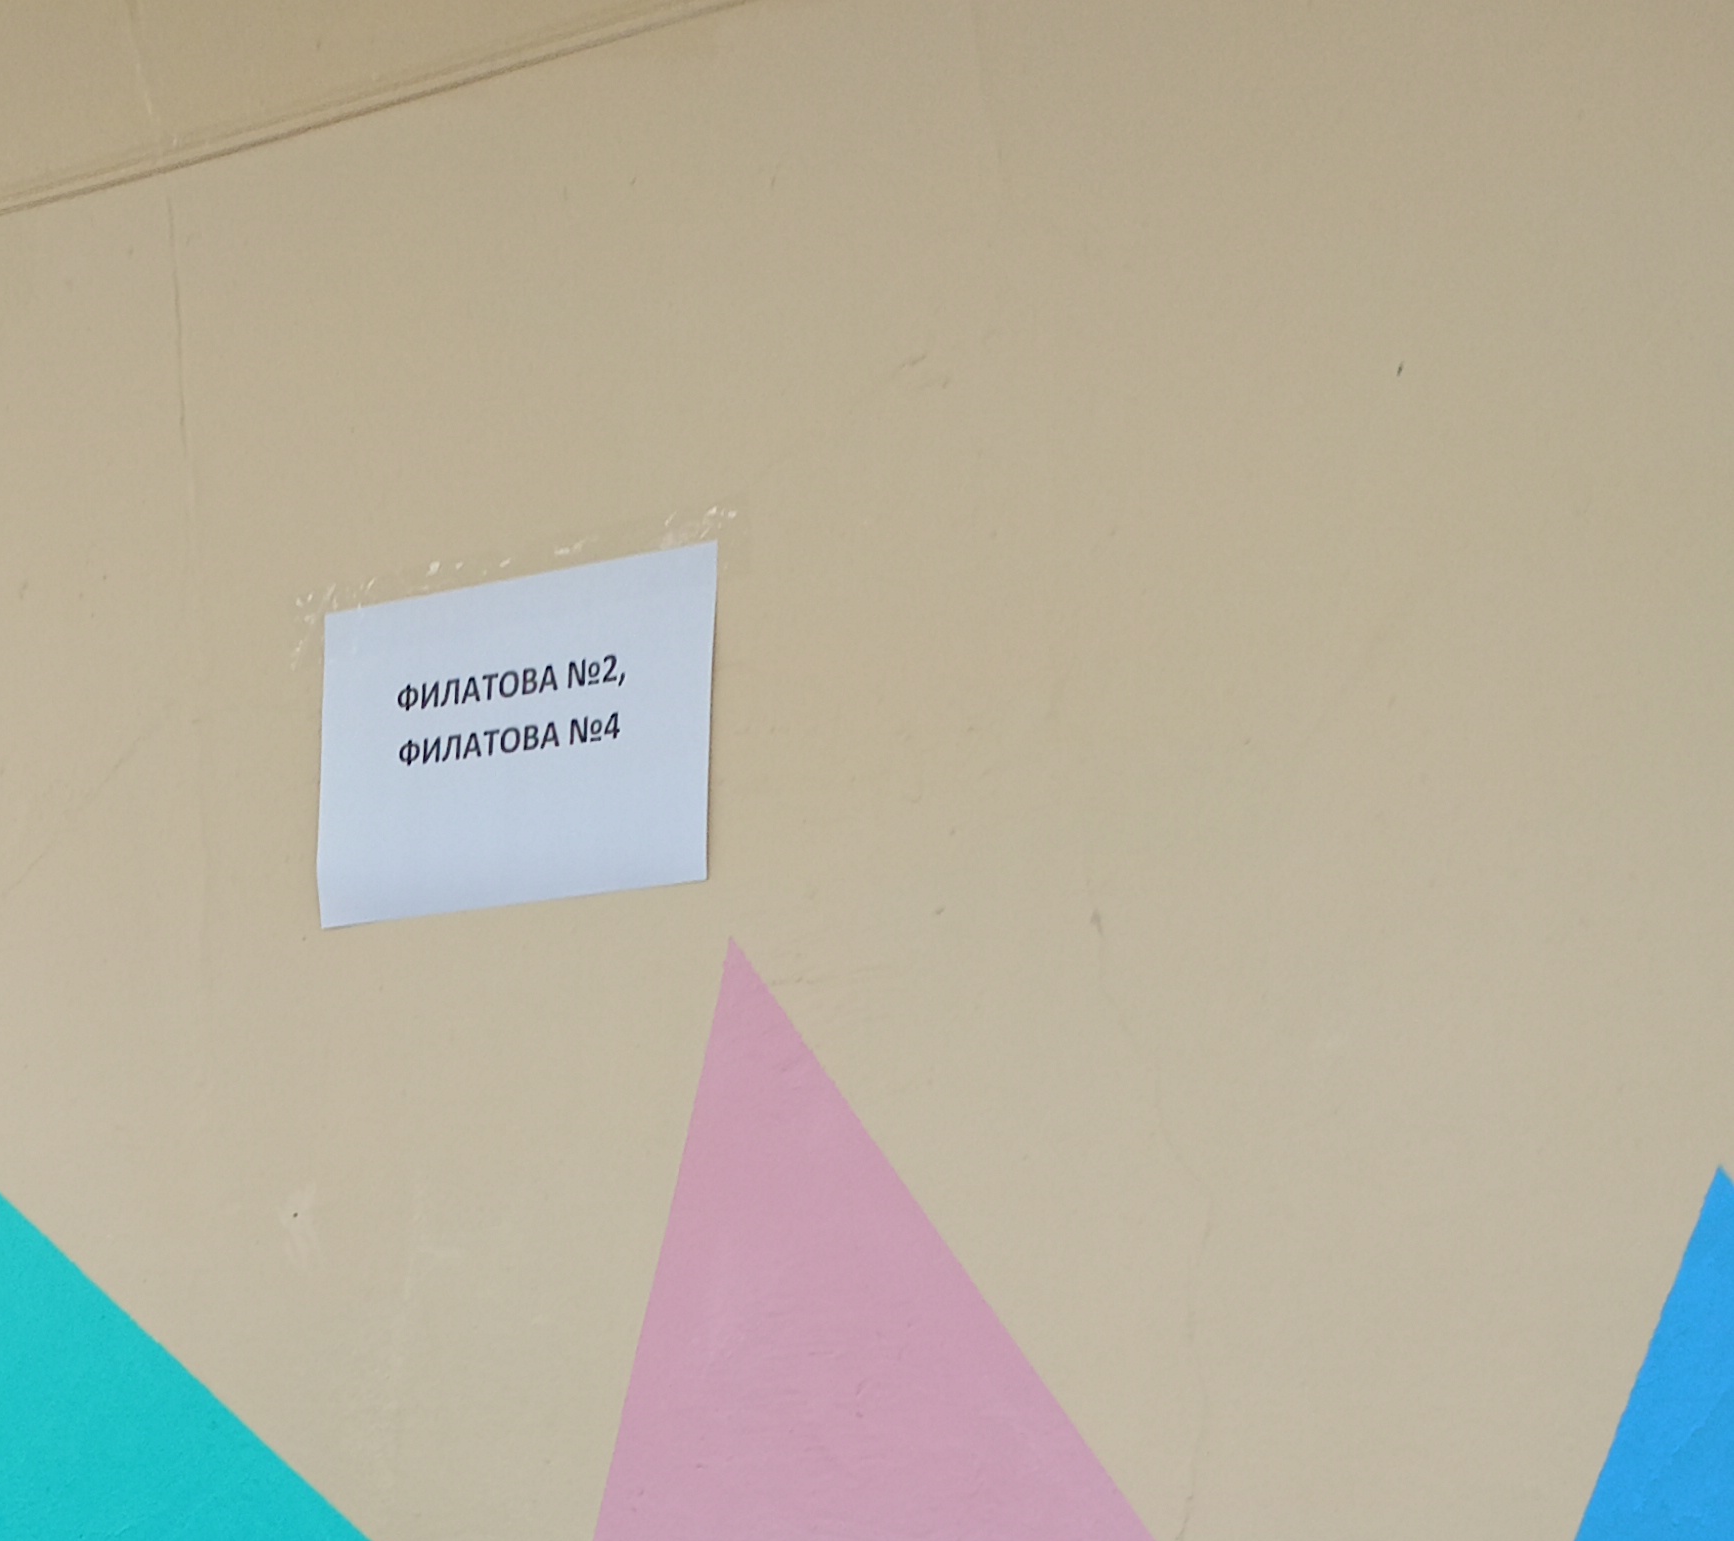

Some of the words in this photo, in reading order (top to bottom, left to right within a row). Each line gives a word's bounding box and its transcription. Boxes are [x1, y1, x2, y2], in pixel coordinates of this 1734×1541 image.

[397, 664, 559, 711] ФИЛАТОВА
[567, 654, 626, 688] №2,
[398, 721, 560, 766] ФИЛАТОВА
[569, 711, 621, 746] №4
